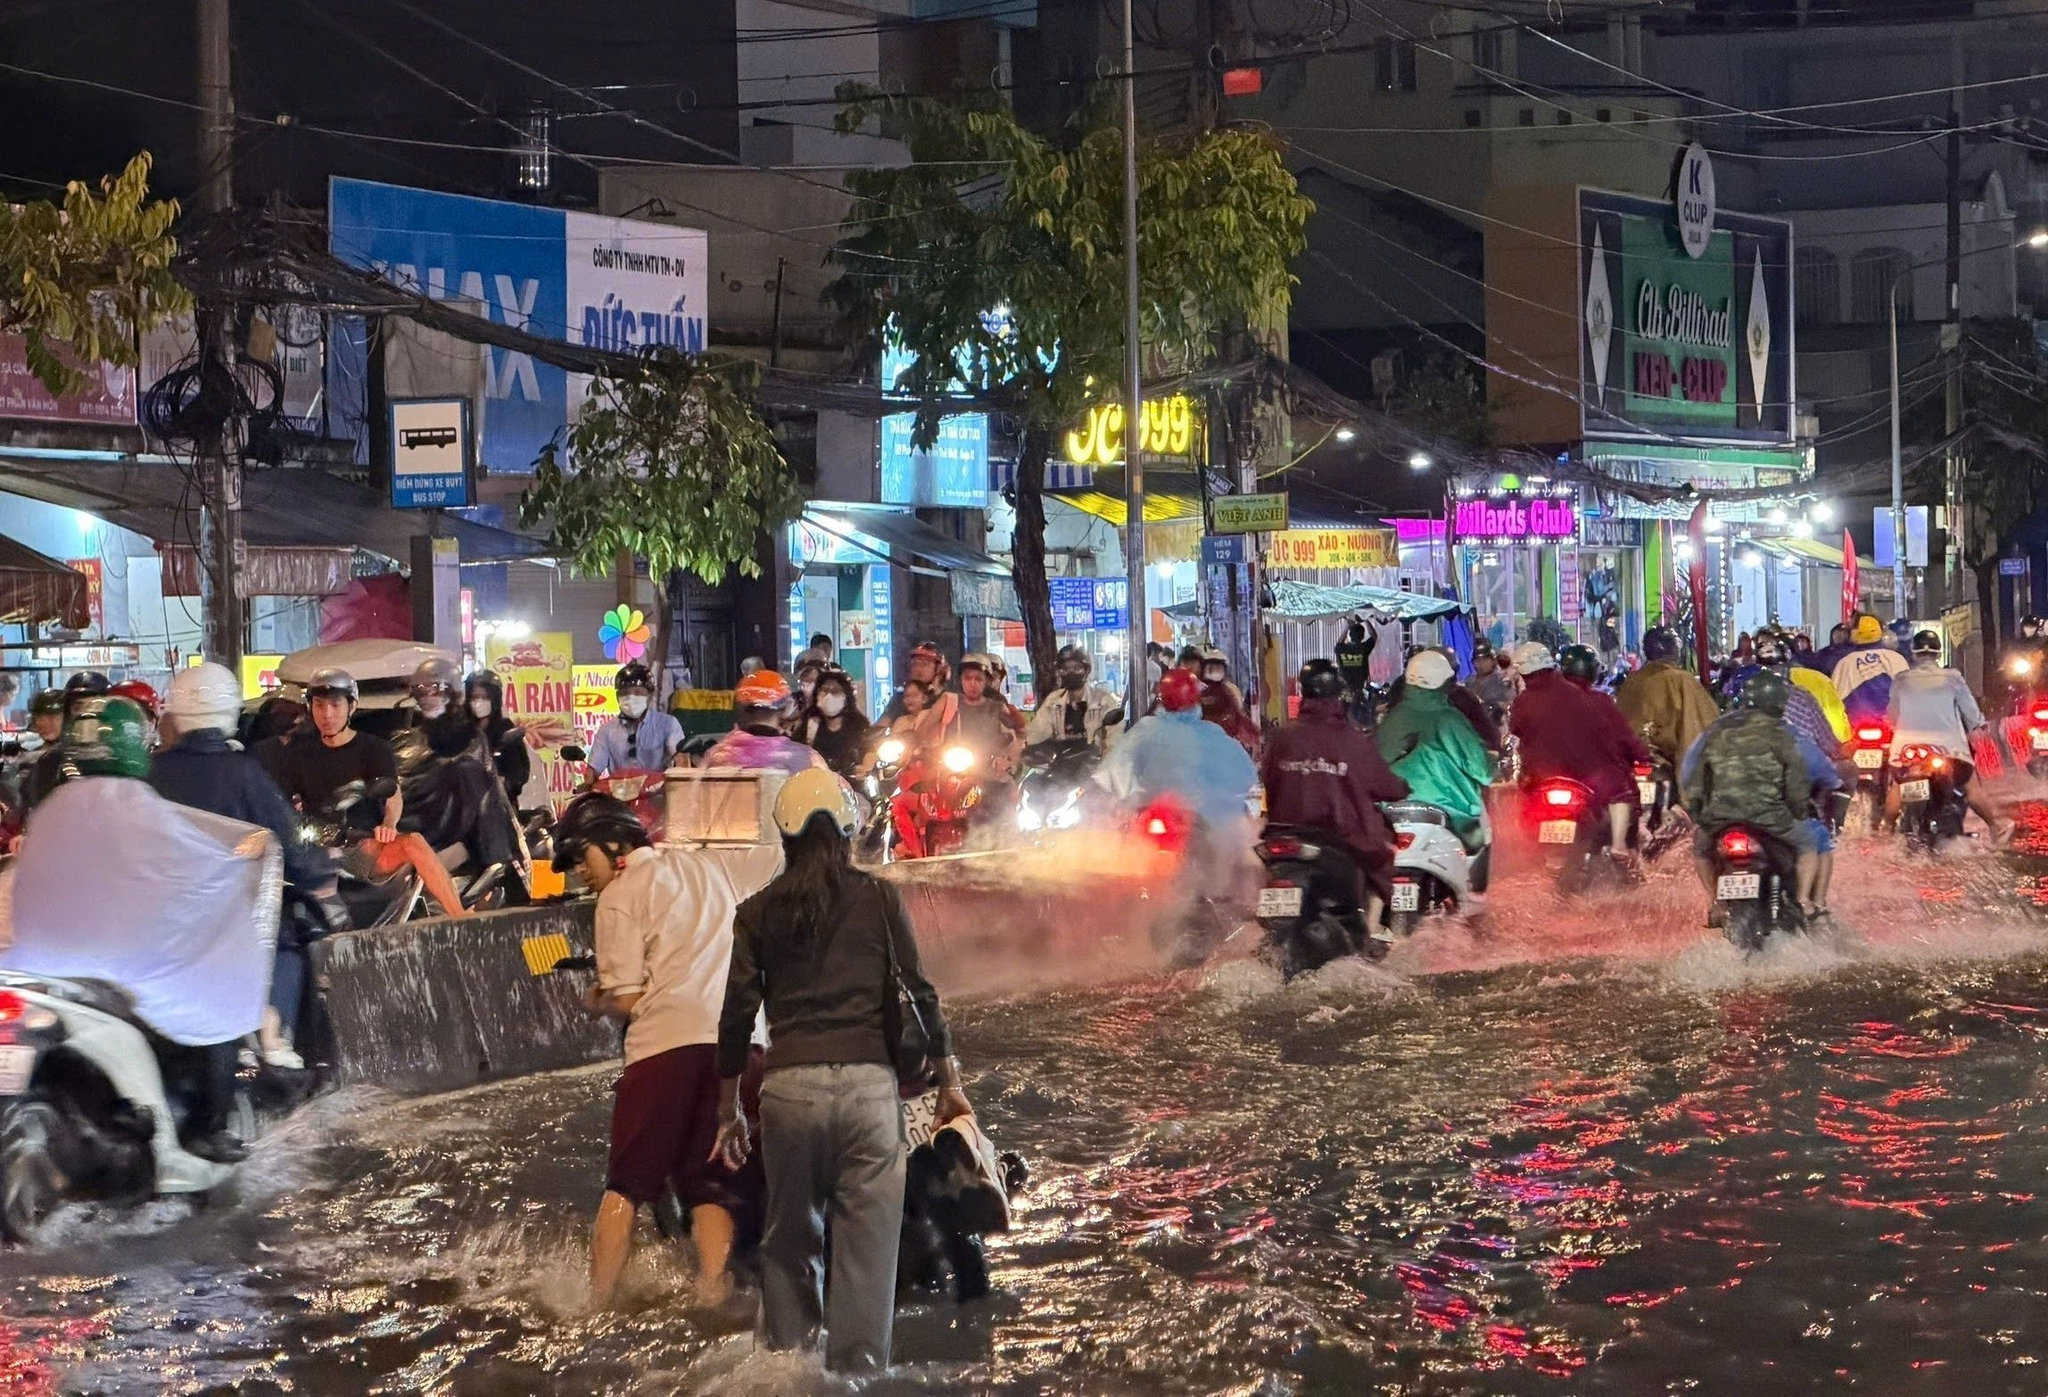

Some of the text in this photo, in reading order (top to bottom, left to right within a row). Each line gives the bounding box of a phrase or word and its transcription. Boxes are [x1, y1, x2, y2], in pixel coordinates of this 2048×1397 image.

[1689, 158, 1702, 195] K
[1683, 200, 1708, 225] CLUP
[593, 244, 613, 269] CÔNG
[614, 250, 623, 271] TY
[624, 252, 644, 273] TNHH
[644, 254, 660, 275] MTV
[660, 256, 671, 276] TM
[675, 258, 686, 278] DV
[435, 478, 445, 487] XE
[413, 491, 446, 502] BUS STOP
[1217, 505, 1283, 525] VIỆT ANH
[1455, 499, 1574, 536] Billards Club
[1273, 531, 1316, 563] ỐC 999
[1317, 532, 1339, 551] XÀO
[1216, 550, 1231, 559] 129
[525, 675, 571, 714] RÁN
[576, 694, 599, 705] 27
